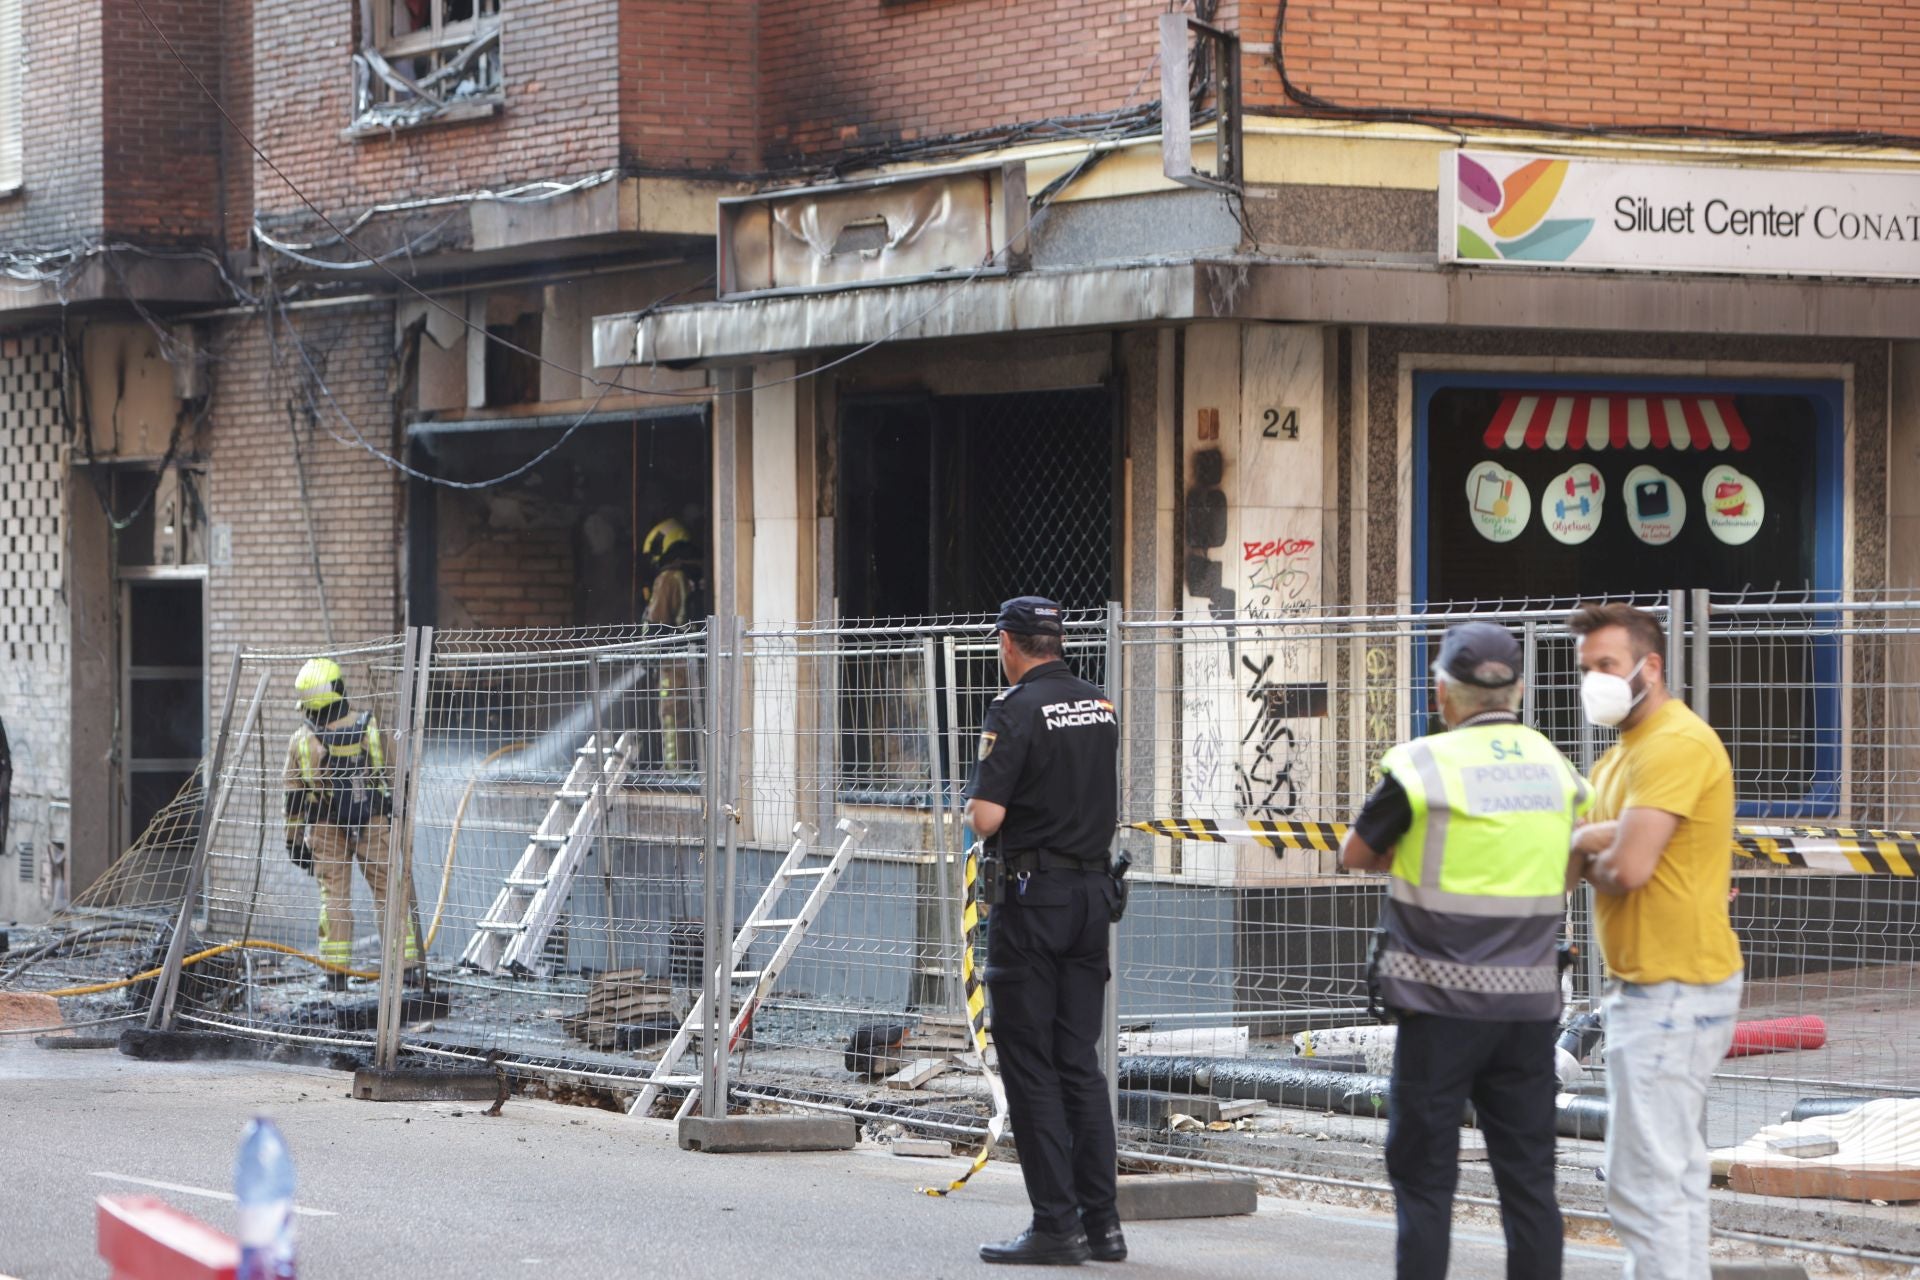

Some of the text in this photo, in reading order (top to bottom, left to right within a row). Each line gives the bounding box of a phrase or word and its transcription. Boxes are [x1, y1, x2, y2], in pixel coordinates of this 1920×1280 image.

[1614, 196, 1920, 241] Siluet Center CONAT
[1262, 408, 1299, 438] 24
[1041, 699, 1105, 717] POLICIA
[1480, 794, 1555, 813] ZAMORA
